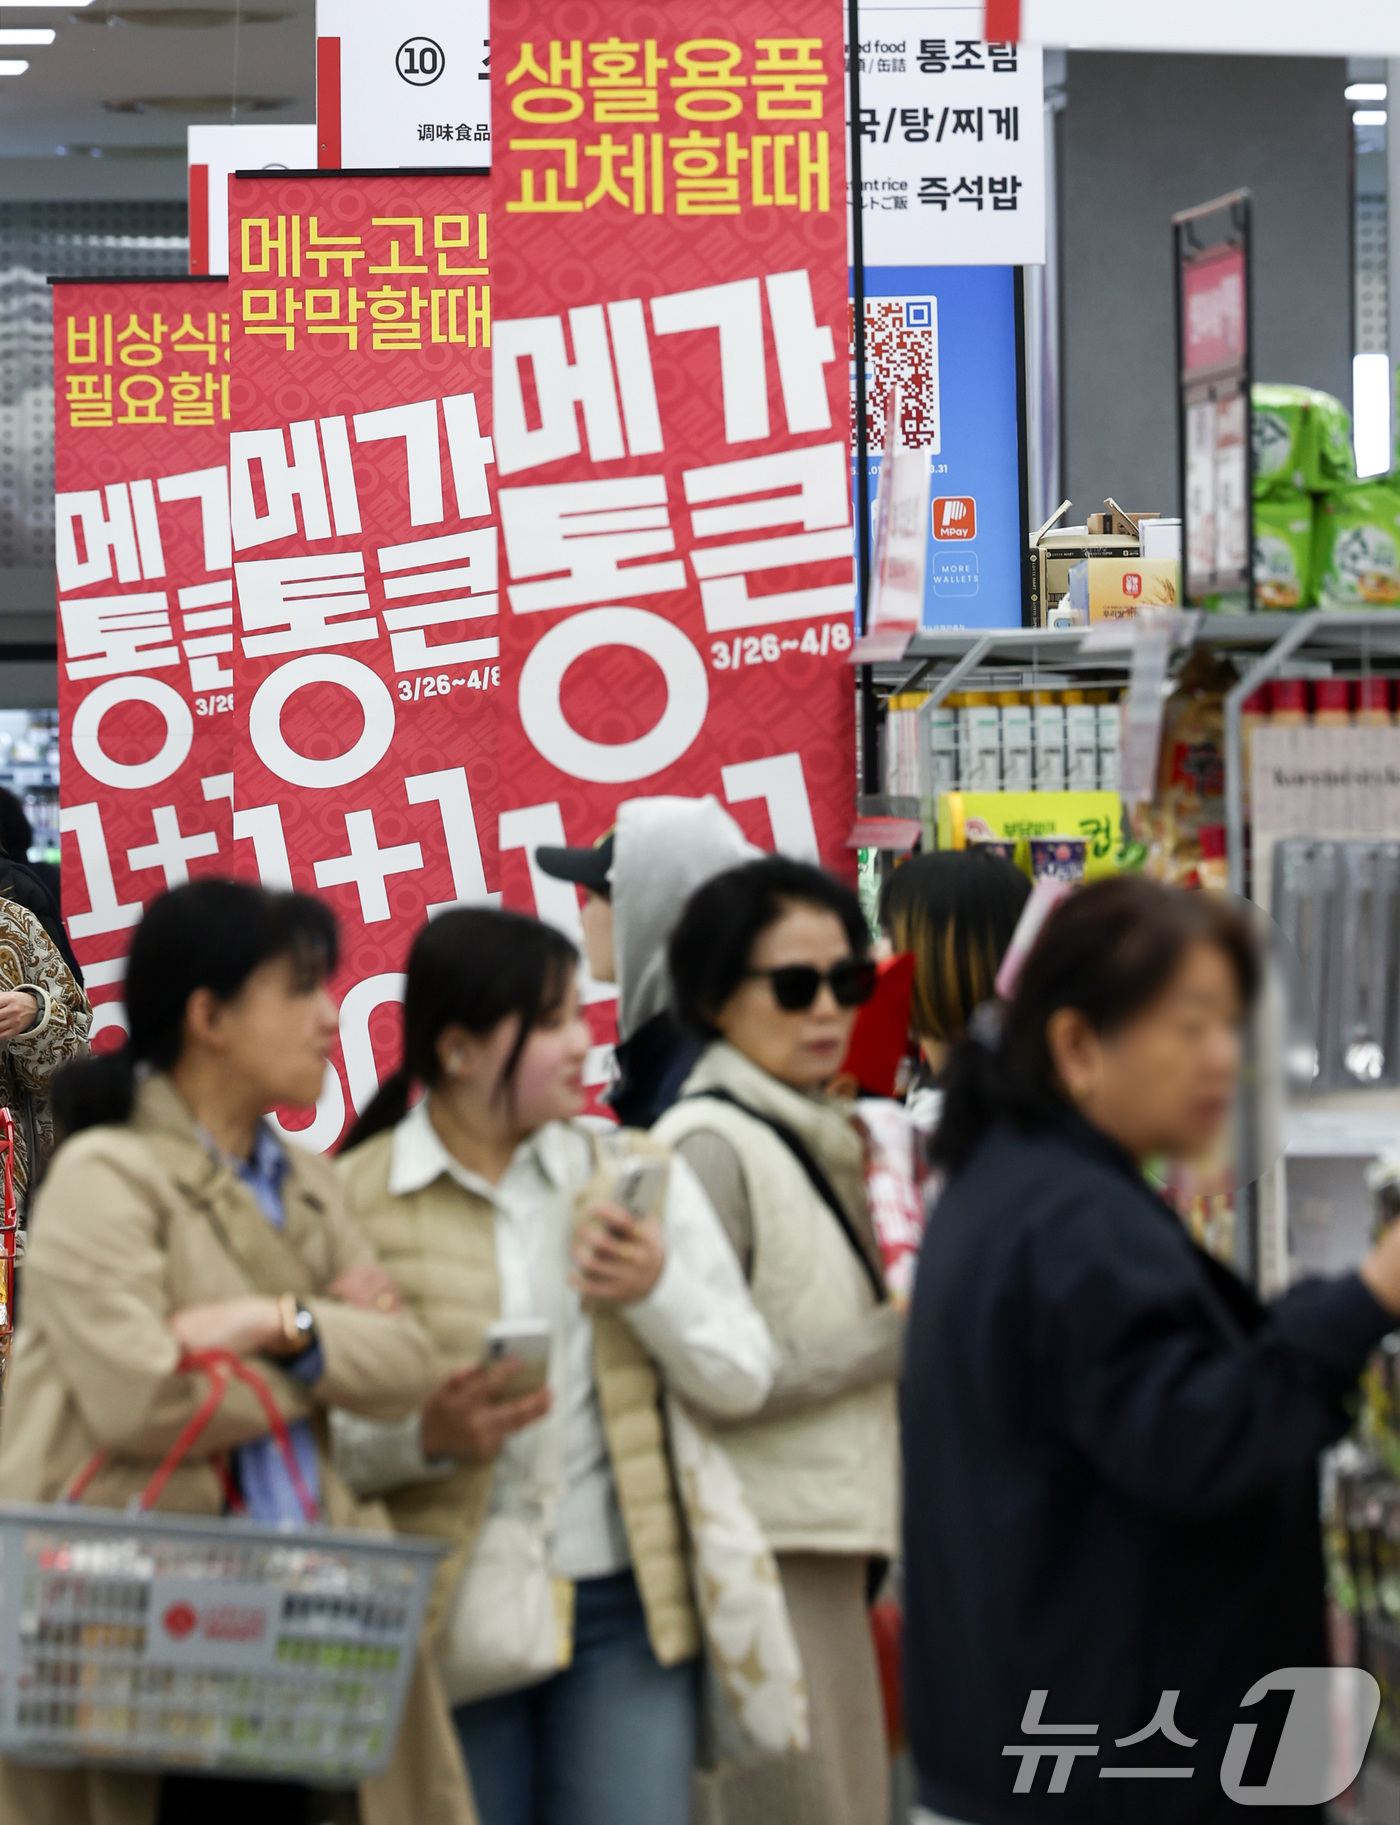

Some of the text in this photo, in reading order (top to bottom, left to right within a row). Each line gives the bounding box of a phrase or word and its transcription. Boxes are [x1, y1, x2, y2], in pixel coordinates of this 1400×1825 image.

[874, 40, 906, 53] food
[916, 39, 1018, 73] 통조림
[506, 36, 829, 124] 생활용품
[416, 123, 491, 143] 调味食品
[506, 130, 830, 215] 교체할때
[882, 178, 907, 191] rice
[917, 175, 1022, 211] 즉석밥
[241, 213, 489, 277] 메뉴고민
[66, 312, 230, 367] 비상식
[243, 285, 491, 351] 막막할때
[492, 269, 836, 476] 메가
[230, 393, 495, 551] 메가
[940, 528, 969, 537] MPay
[933, 575, 979, 583] WALLETS
[941, 565, 970, 573] MORE
[498, 441, 855, 784] 통큰
[234, 526, 500, 788] 통큰
[711, 623, 851, 670] 3/26~4/8
